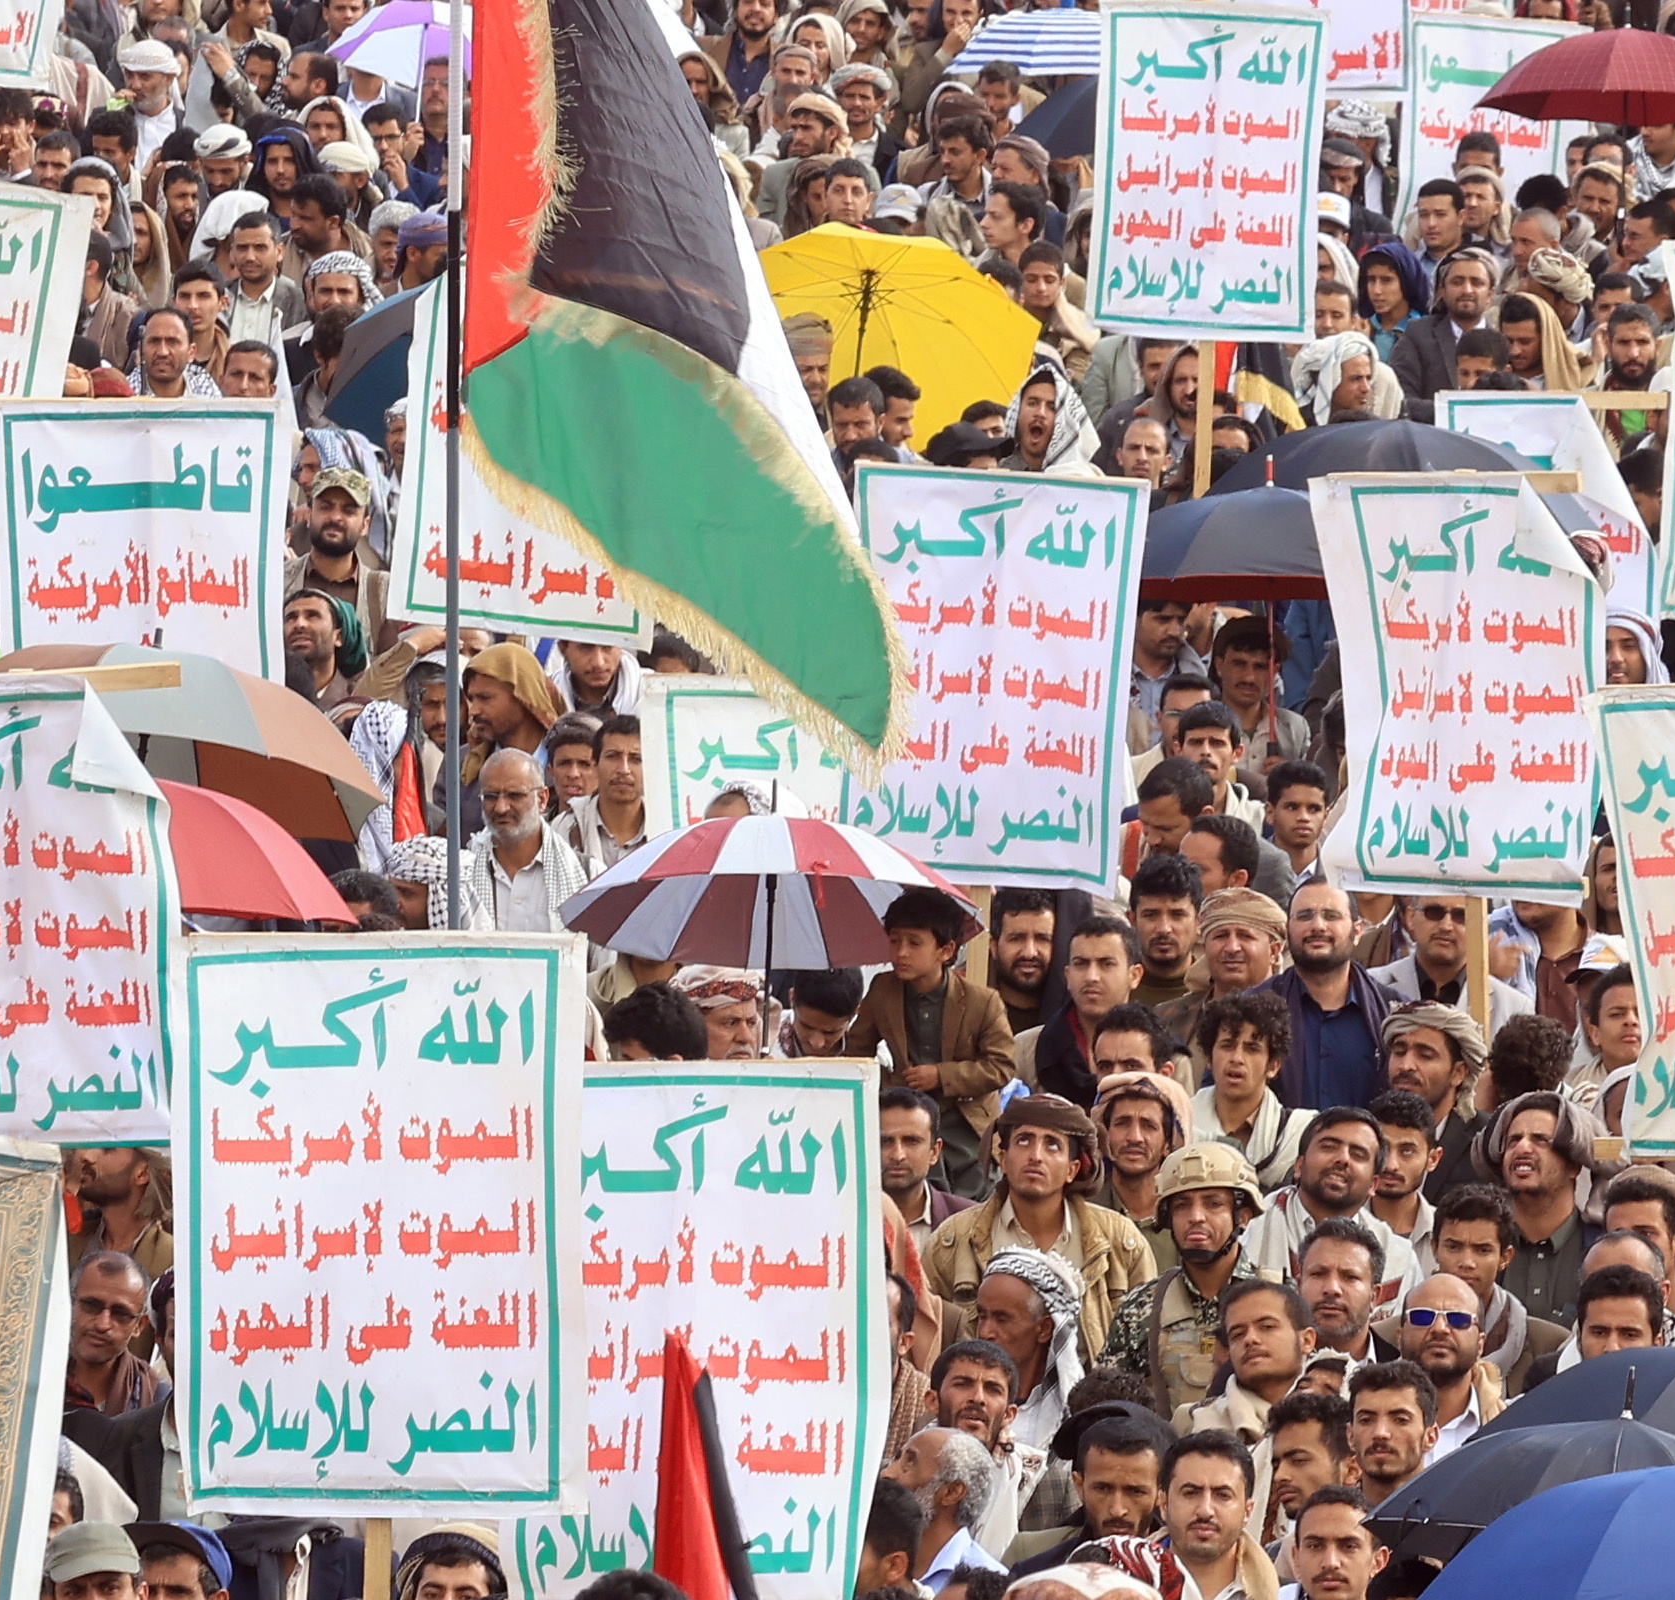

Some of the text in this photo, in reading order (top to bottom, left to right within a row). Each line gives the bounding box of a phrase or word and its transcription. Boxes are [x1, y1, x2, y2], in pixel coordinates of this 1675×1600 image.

[1124, 29, 1307, 94] الله أكبر
[1122, 99, 1299, 144] الموت لأمريكا
[1113, 210, 1292, 249] اللعنة على اليهود
[1106, 251, 1292, 323] النصر للإسلام
[22, 444, 252, 533] قاطعوا
[880, 489, 1116, 573] الله أكبر
[27, 541, 249, 622] البضائع الأمريكية
[31, 832, 147, 881] الموت
[854, 785, 1093, 855] النصر للإسلام
[209, 968, 534, 1098] الله أكبر
[35, 1046, 158, 1130] النصر
[212, 1093, 534, 1176] الموت لأمريكا
[211, 1200, 537, 1273] الموت لإسرائيل
[209, 1291, 538, 1366] اللعنة على اليهود
[208, 1373, 536, 1479] النصر للإسلام
